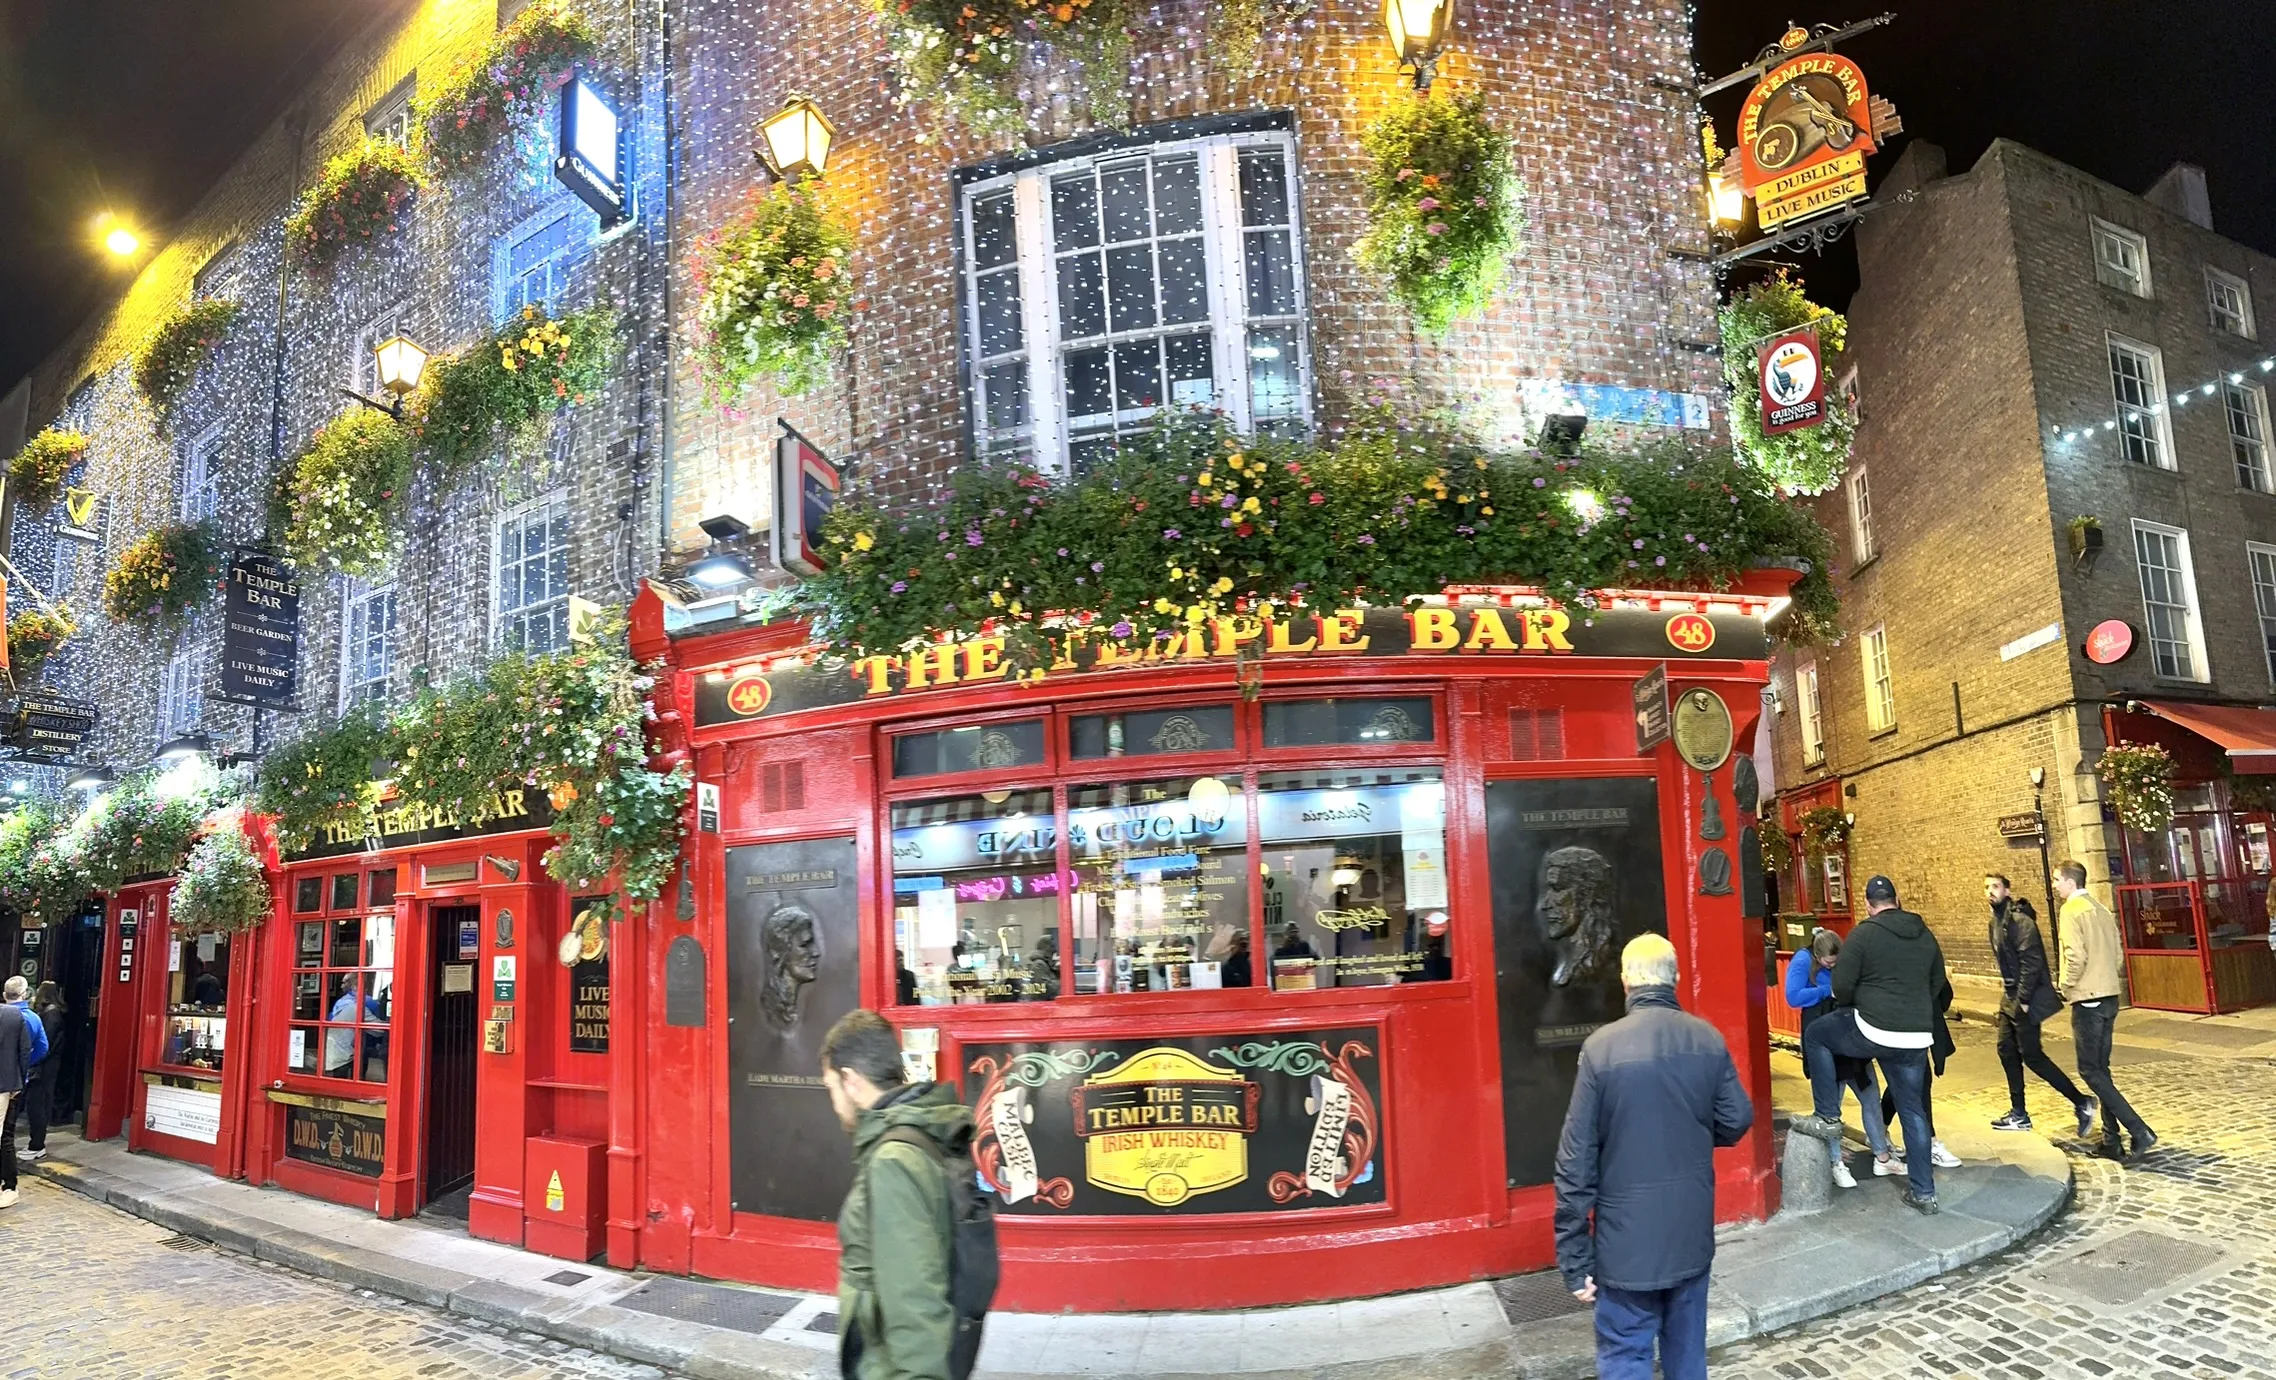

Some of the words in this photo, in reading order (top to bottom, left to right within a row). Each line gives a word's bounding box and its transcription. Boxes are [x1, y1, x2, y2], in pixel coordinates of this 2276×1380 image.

[1743, 104, 1762, 145] THE
[1757, 59, 1836, 100] TEMPLE
[1835, 65, 1862, 106] BAR
[1775, 160, 1840, 193] DUBLIN
[1766, 200, 1801, 221] LIVE
[1807, 180, 1856, 207] MUSIC
[1771, 401, 1817, 419] GUINNESS
[1778, 415, 1795, 425] good
[1804, 410, 1817, 419] you
[255, 564, 277, 577] THE
[233, 568, 297, 596] TEMPLE
[247, 589, 281, 609] BAR
[231, 622, 255, 634] BEER
[255, 628, 292, 642] GARDEN
[1674, 620, 1706, 645] 48
[852, 637, 1011, 696] THE
[1405, 608, 1576, 655] BAR
[231, 660, 255, 672] LIVE
[256, 665, 288, 678] MUSIC
[244, 674, 275, 687] DAILY
[735, 685, 762, 709] 48
[23, 701, 42, 711] THE
[42, 703, 77, 715] TEMPLE
[78, 709, 96, 718] BAR
[32, 729, 84, 741] DISTILLERY
[42, 744, 72, 754] STORE
[1142, 788, 1167, 800] The
[1522, 813, 1545, 822] THE
[1551, 810, 1601, 822] TEMPLE
[1603, 808, 1628, 819] BAR
[746, 876, 764, 886] THE
[768, 871, 808, 884] TEMPLE
[811, 870, 834, 881] BAR
[1197, 874, 1236, 886] Salmon
[580, 986, 609, 1001] LIVE
[1020, 983, 1047, 995] 2024
[1144, 1086, 1184, 1103] THE
[1088, 1105, 1184, 1129] TEMPLE
[1191, 1104, 1242, 1126] BAR
[293, 1119, 320, 1150] D.W.D.
[1003, 1102, 1036, 1181] MALBEC
[1102, 1133, 1144, 1154] IRISH
[1148, 1132, 1230, 1151] WHISKEY
[1309, 1101, 1335, 1177] EDITION
[1320, 1093, 1348, 1182] LIMITED
[353, 1130, 384, 1163] D.W.D.
[998, 1121, 1021, 1172] CASK
